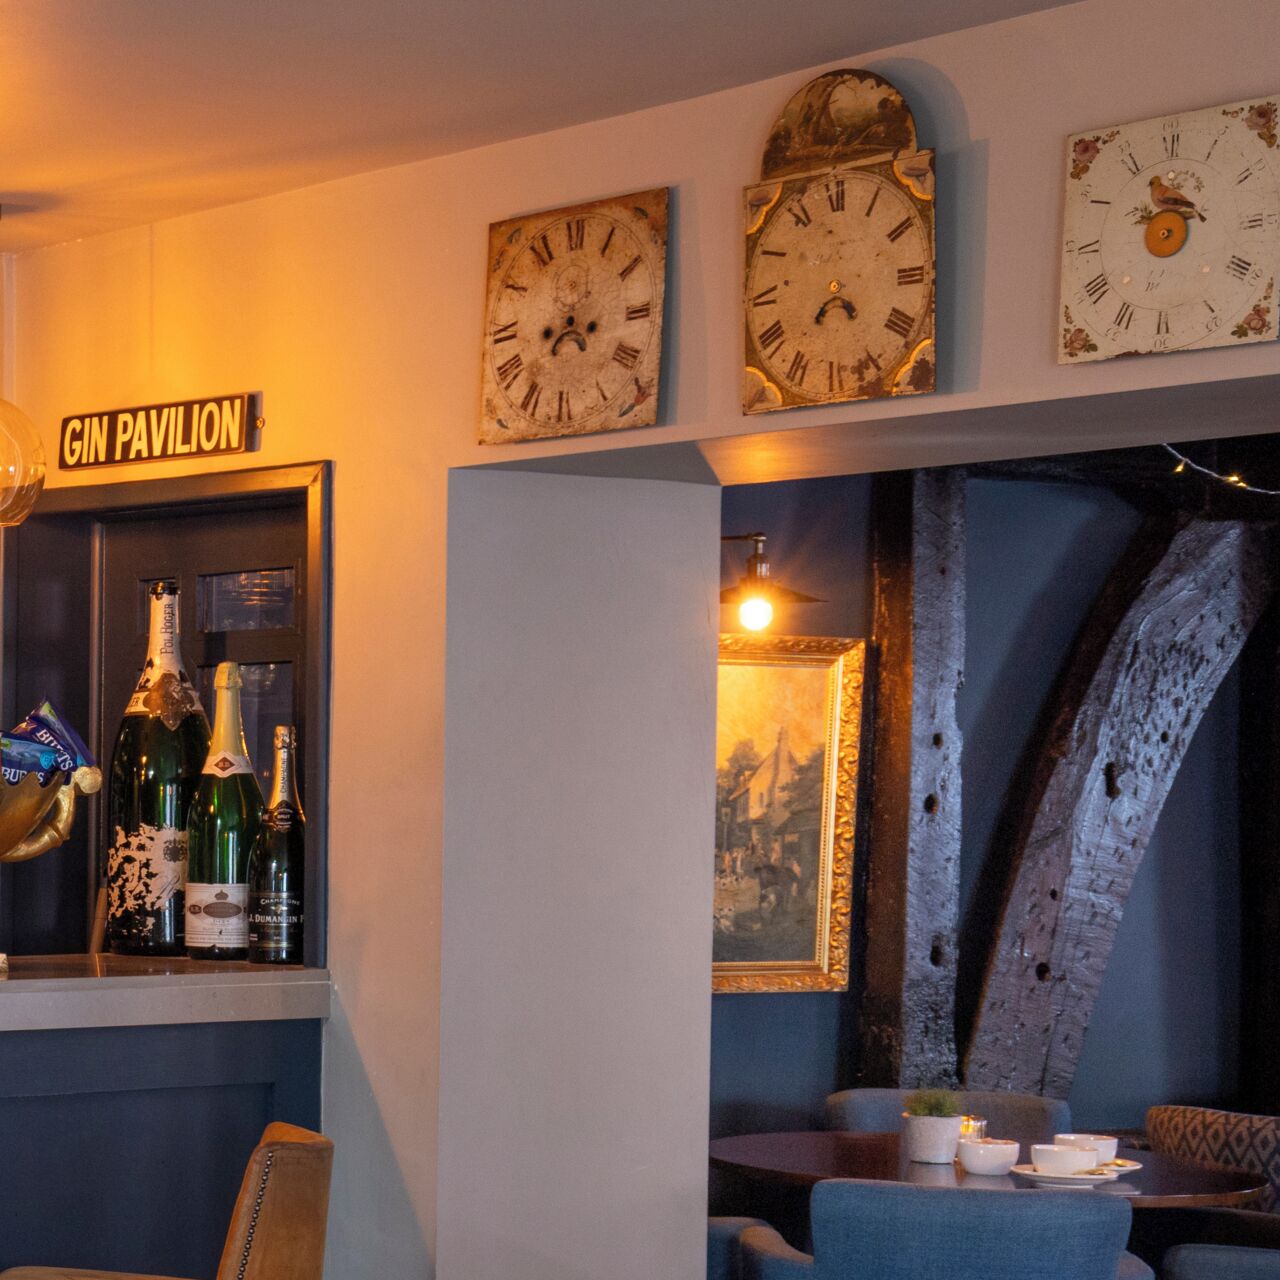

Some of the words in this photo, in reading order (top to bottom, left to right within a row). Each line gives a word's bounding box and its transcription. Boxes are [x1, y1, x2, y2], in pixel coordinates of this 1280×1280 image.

[64, 415, 108, 466] GIN
[115, 398, 241, 461] PAVILION
[36, 729, 73, 771] BUTS
[1, 767, 45, 783] BURS
